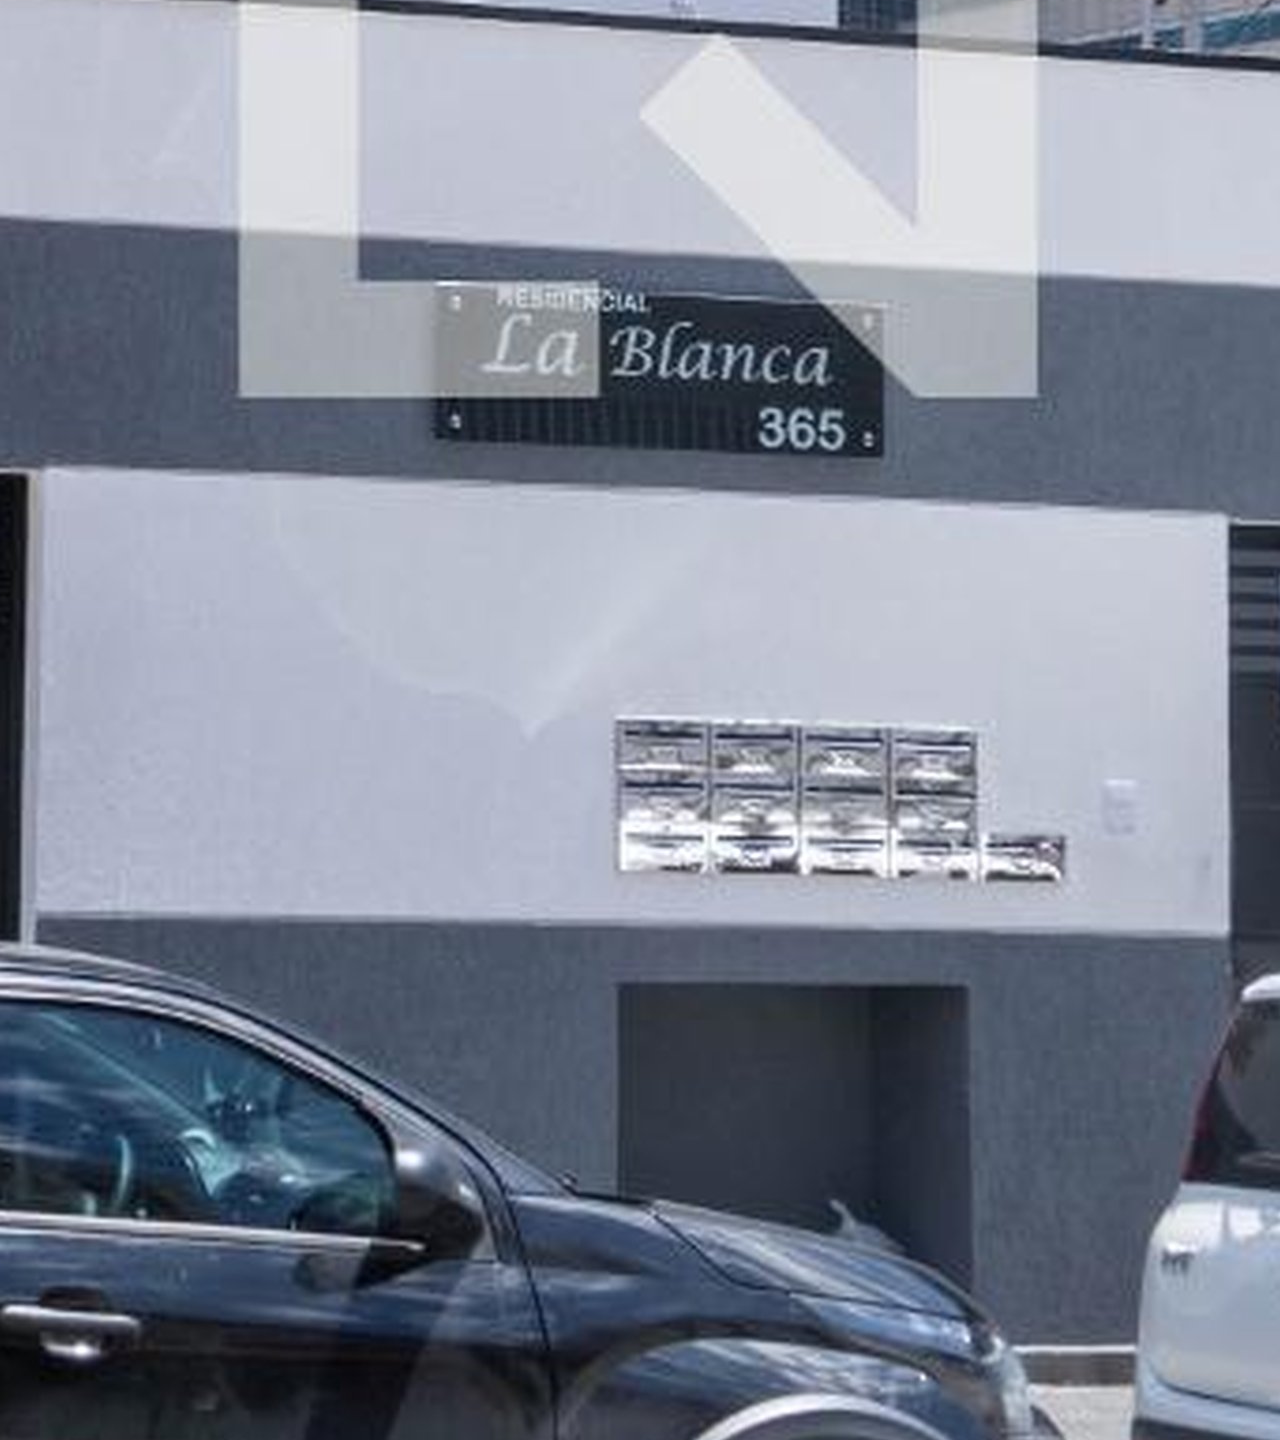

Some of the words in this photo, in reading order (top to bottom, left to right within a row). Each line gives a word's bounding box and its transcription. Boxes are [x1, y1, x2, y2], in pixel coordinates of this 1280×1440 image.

[481, 313, 585, 376] La
[609, 321, 834, 387] Blanca
[758, 407, 847, 451] 365
